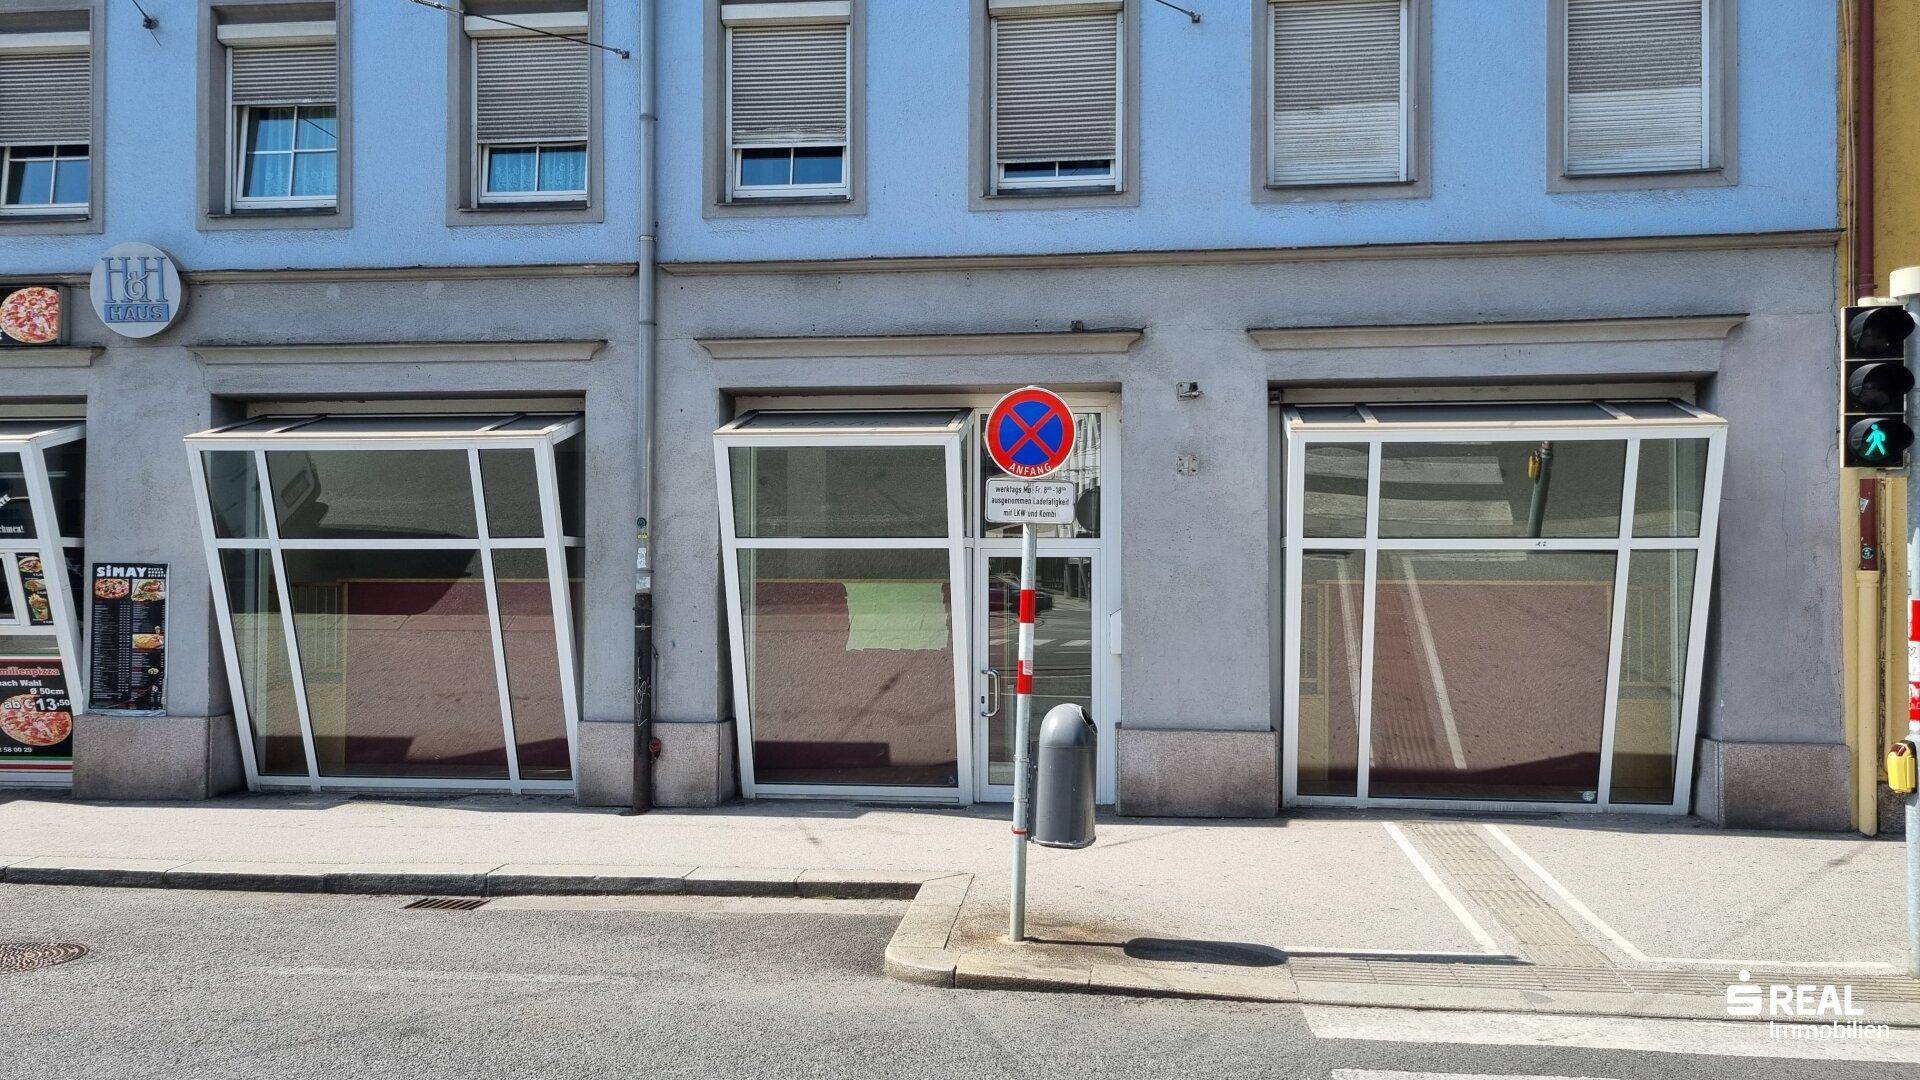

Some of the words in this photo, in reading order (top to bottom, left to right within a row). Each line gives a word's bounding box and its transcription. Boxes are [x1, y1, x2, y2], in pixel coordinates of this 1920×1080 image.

[101, 257, 168, 303] H&H
[109, 305, 163, 321] HAUS
[1009, 463, 1051, 476] ANFANG
[996, 486, 1022, 495] werktags
[1033, 498, 1069, 507] Ladetätigkeit
[1013, 509, 1026, 517] LKW
[1039, 510, 1057, 518] Kombi
[97, 565, 147, 578] SiMAY
[39, 687, 64, 695] 50cm
[4, 700, 21, 709] ab
